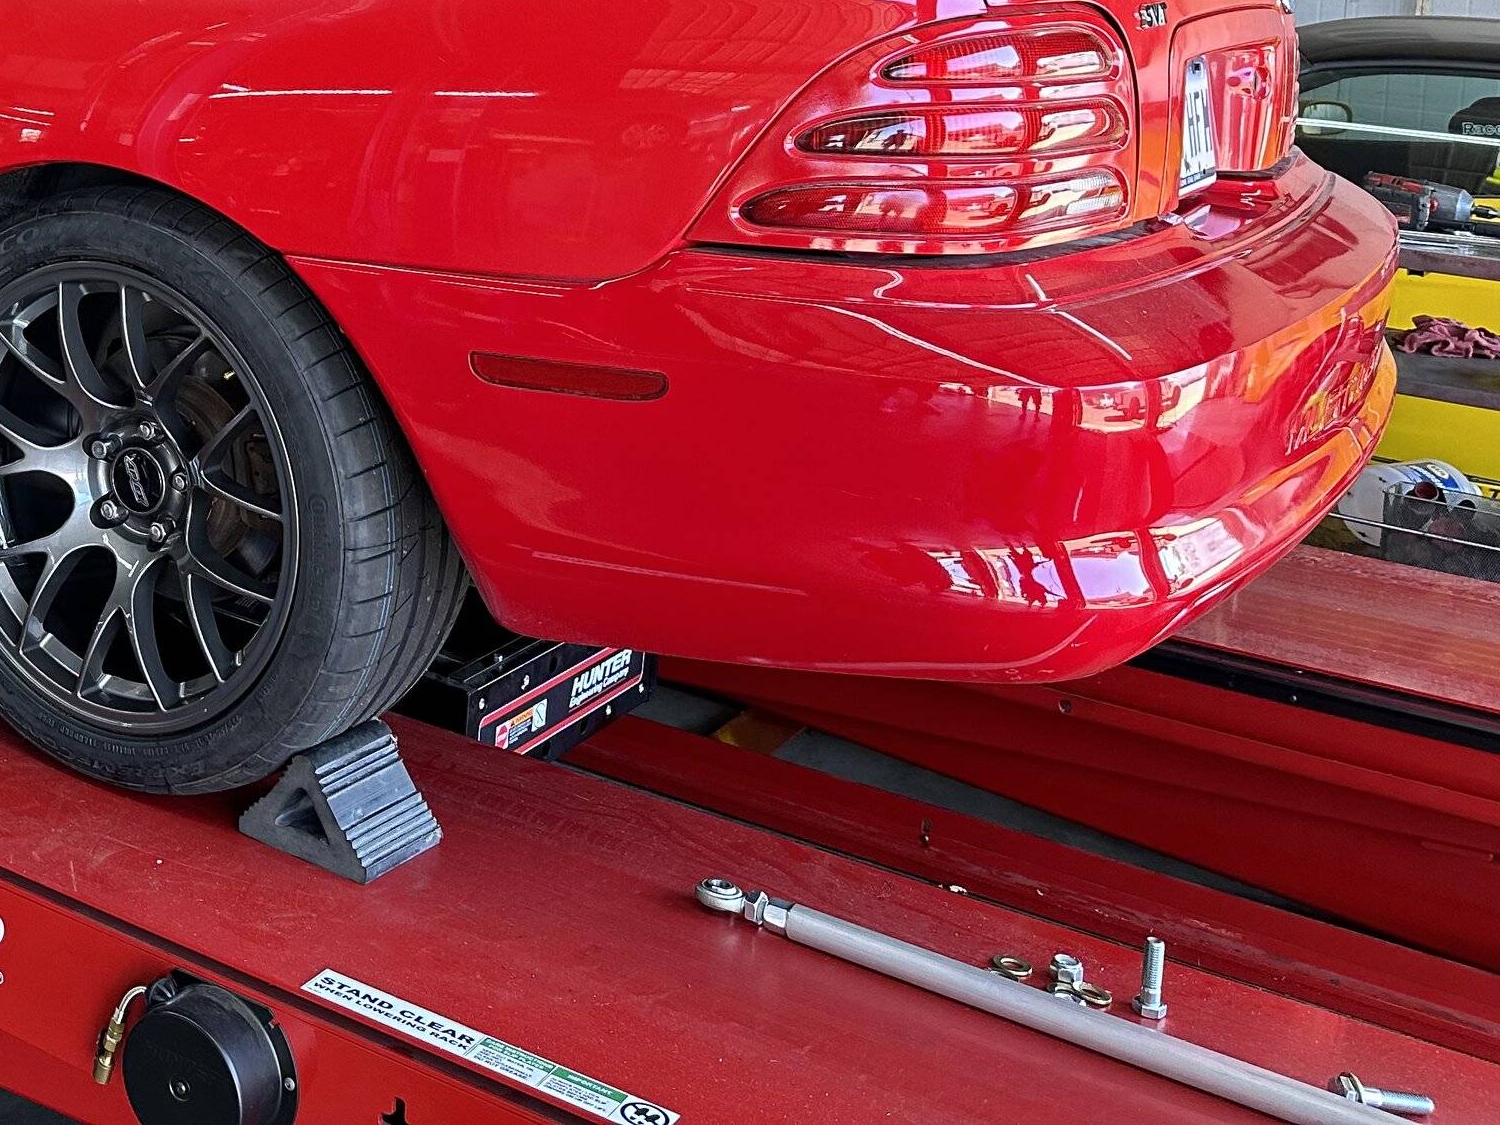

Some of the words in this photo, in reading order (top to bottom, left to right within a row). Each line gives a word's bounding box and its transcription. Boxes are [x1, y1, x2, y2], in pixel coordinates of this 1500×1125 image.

[571, 649, 633, 697] HUNTER
[313, 982, 352, 1001] WHEN
[355, 999, 428, 1033] LOWERING
[429, 1030, 471, 1051] RACK
[320, 976, 394, 1010] STAND
[399, 1009, 475, 1045] CLEAR
[567, 1075, 613, 1095] IMPORTANT
